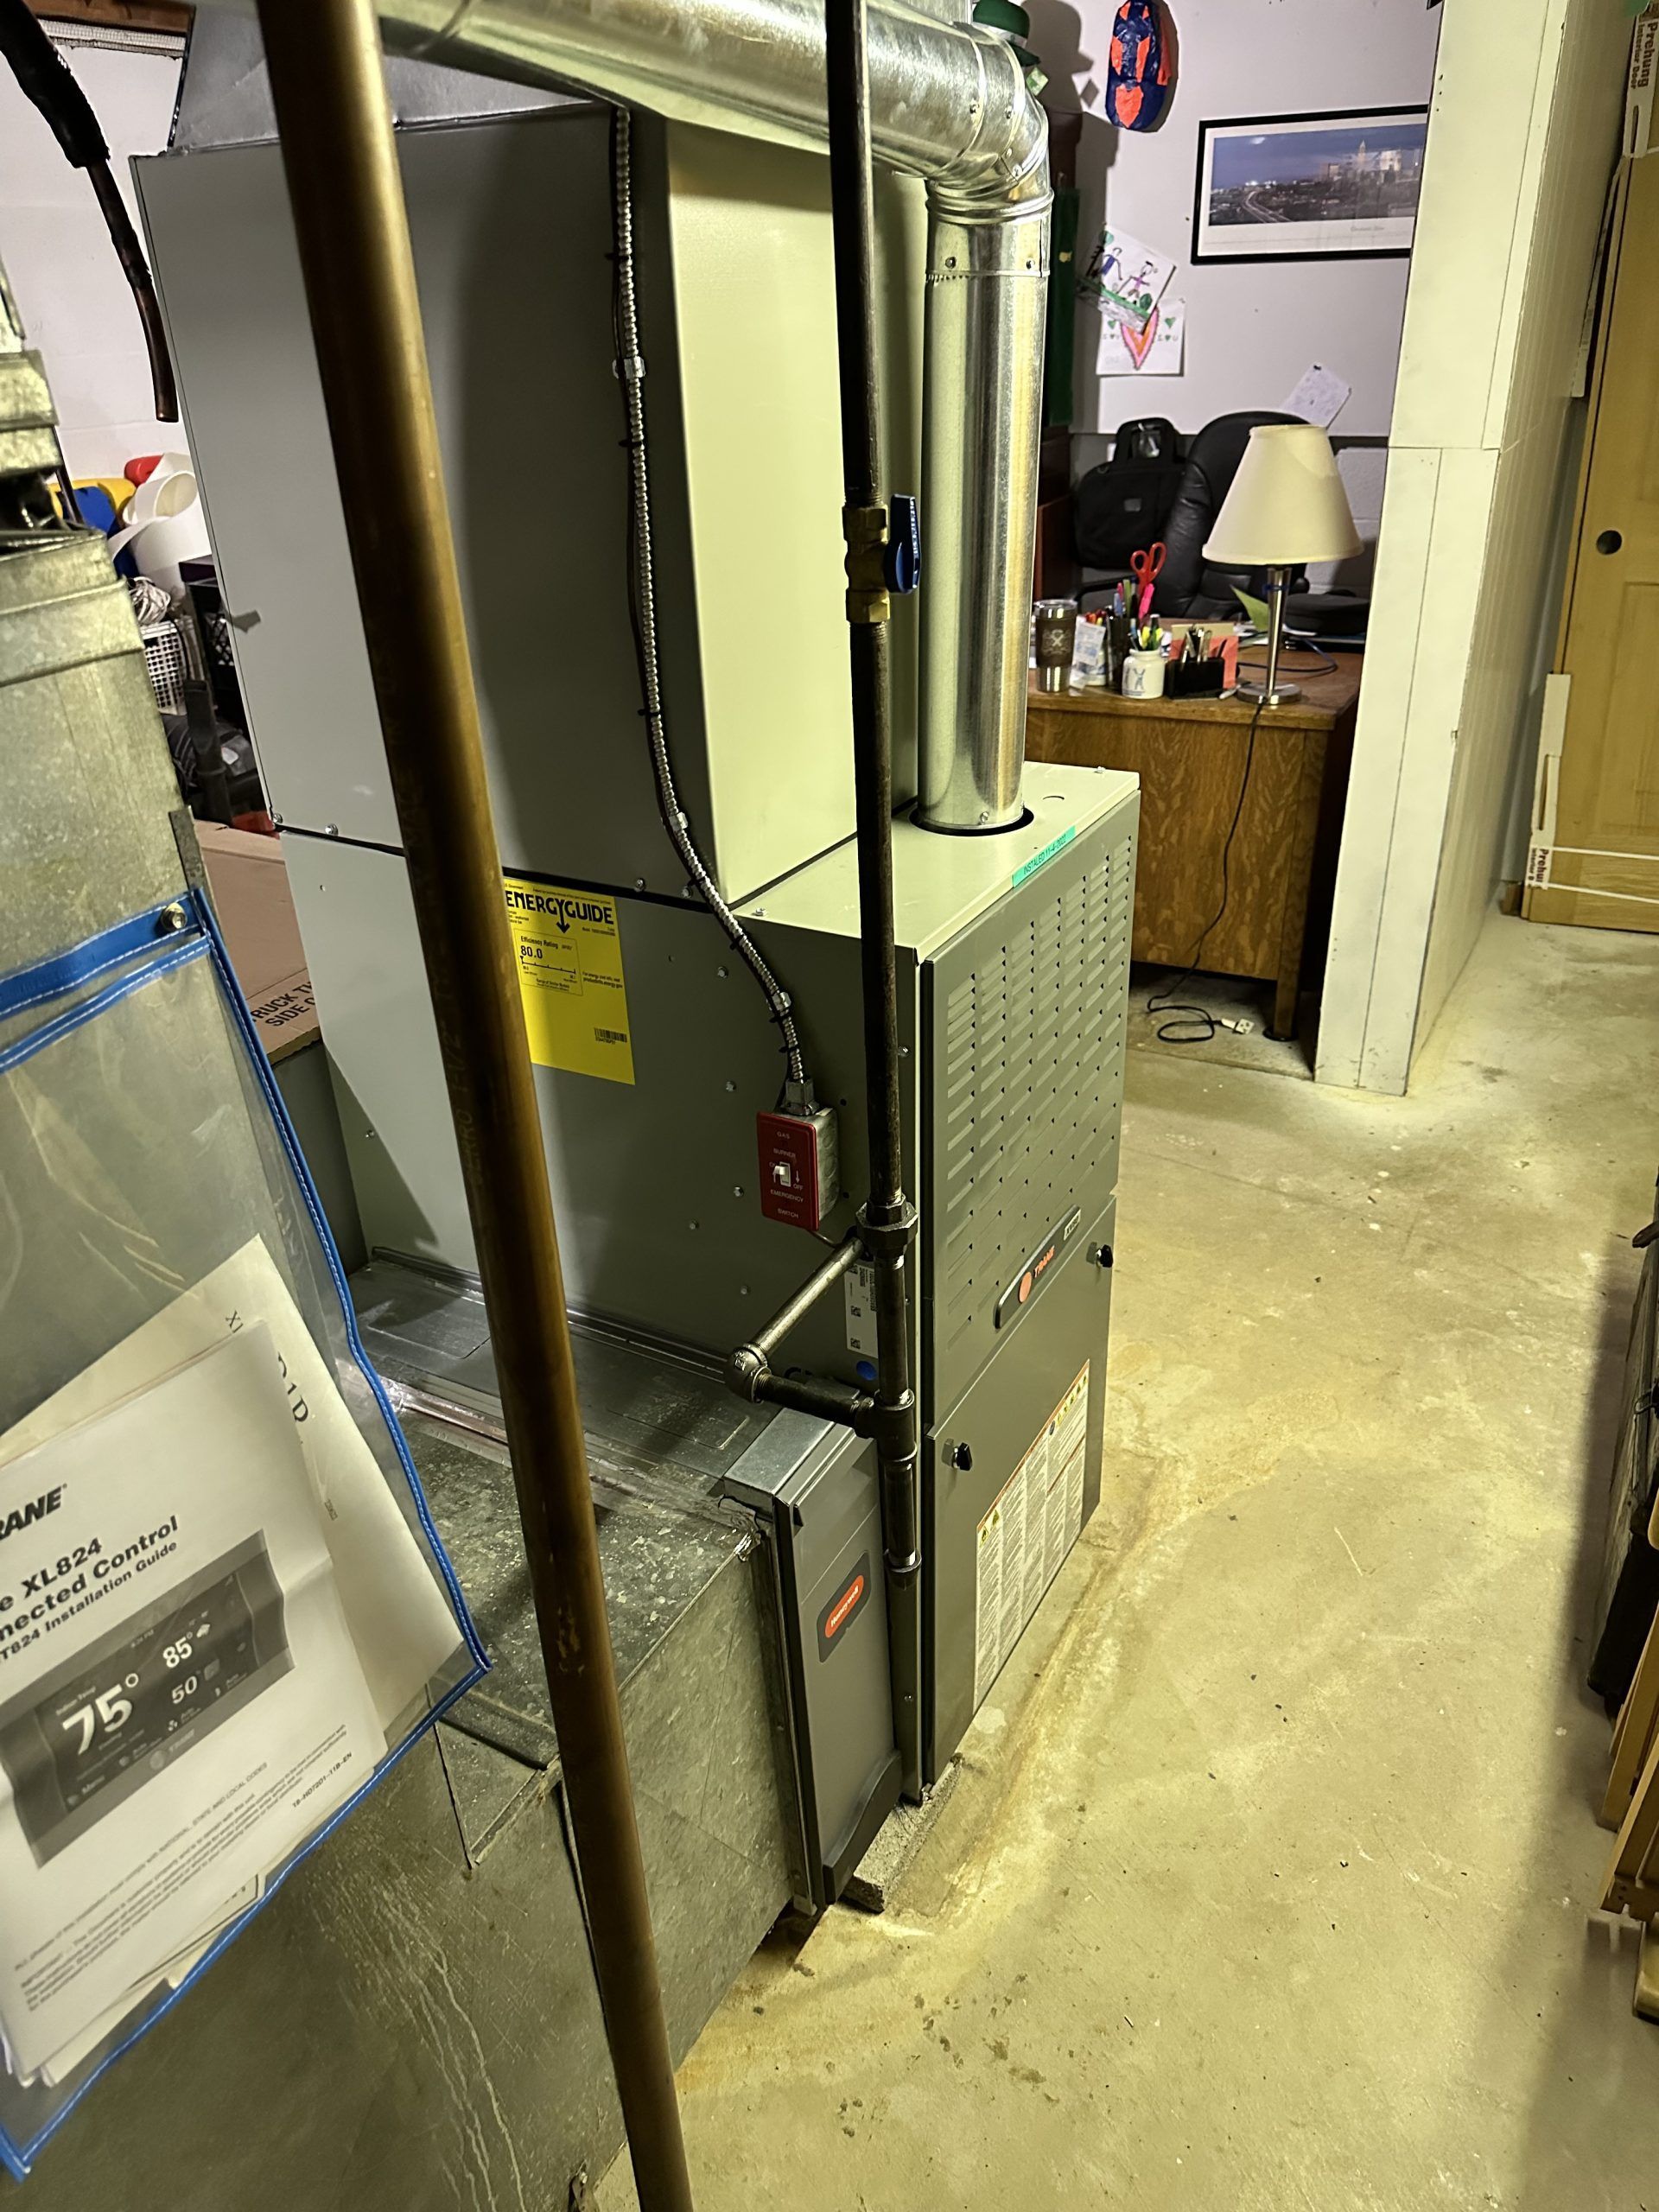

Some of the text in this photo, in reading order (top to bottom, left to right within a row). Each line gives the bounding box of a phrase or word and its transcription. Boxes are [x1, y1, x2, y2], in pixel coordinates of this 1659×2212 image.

[1637, 21, 1658, 87] Prehung
[505, 890, 614, 928] ENERGYGUIDE
[520, 945, 543, 958] 80.0
[250, 993, 298, 1022] RUCK
[265, 1004, 310, 1027] SIDE
[777, 1131, 791, 1140] GAS
[770, 1189, 804, 1204] EMERGENCY
[778, 1207, 799, 1219] SWITCH
[0, 1515, 178, 1641] nected Control
[22, 1537, 103, 1599] XL824
[45, 1570, 132, 1632] Installation
[136, 1541, 177, 1573] Guide
